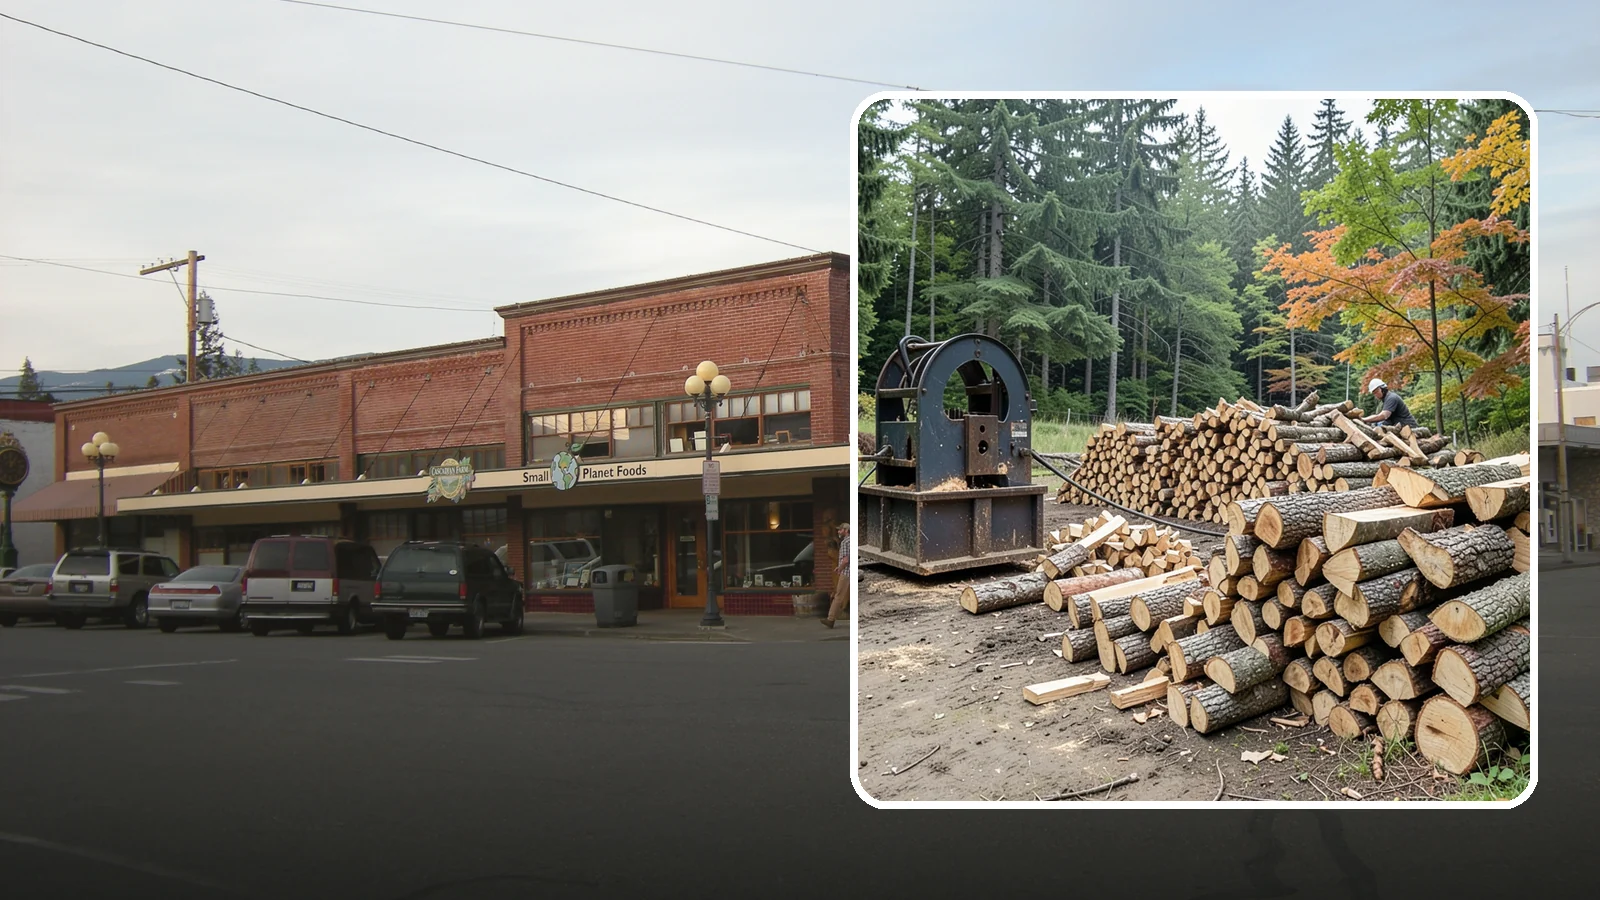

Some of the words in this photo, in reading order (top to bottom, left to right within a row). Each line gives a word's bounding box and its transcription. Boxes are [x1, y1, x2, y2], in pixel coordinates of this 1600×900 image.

[523, 471, 548, 483] Small
[583, 467, 614, 479] Planet
[617, 464, 647, 477] Foods
